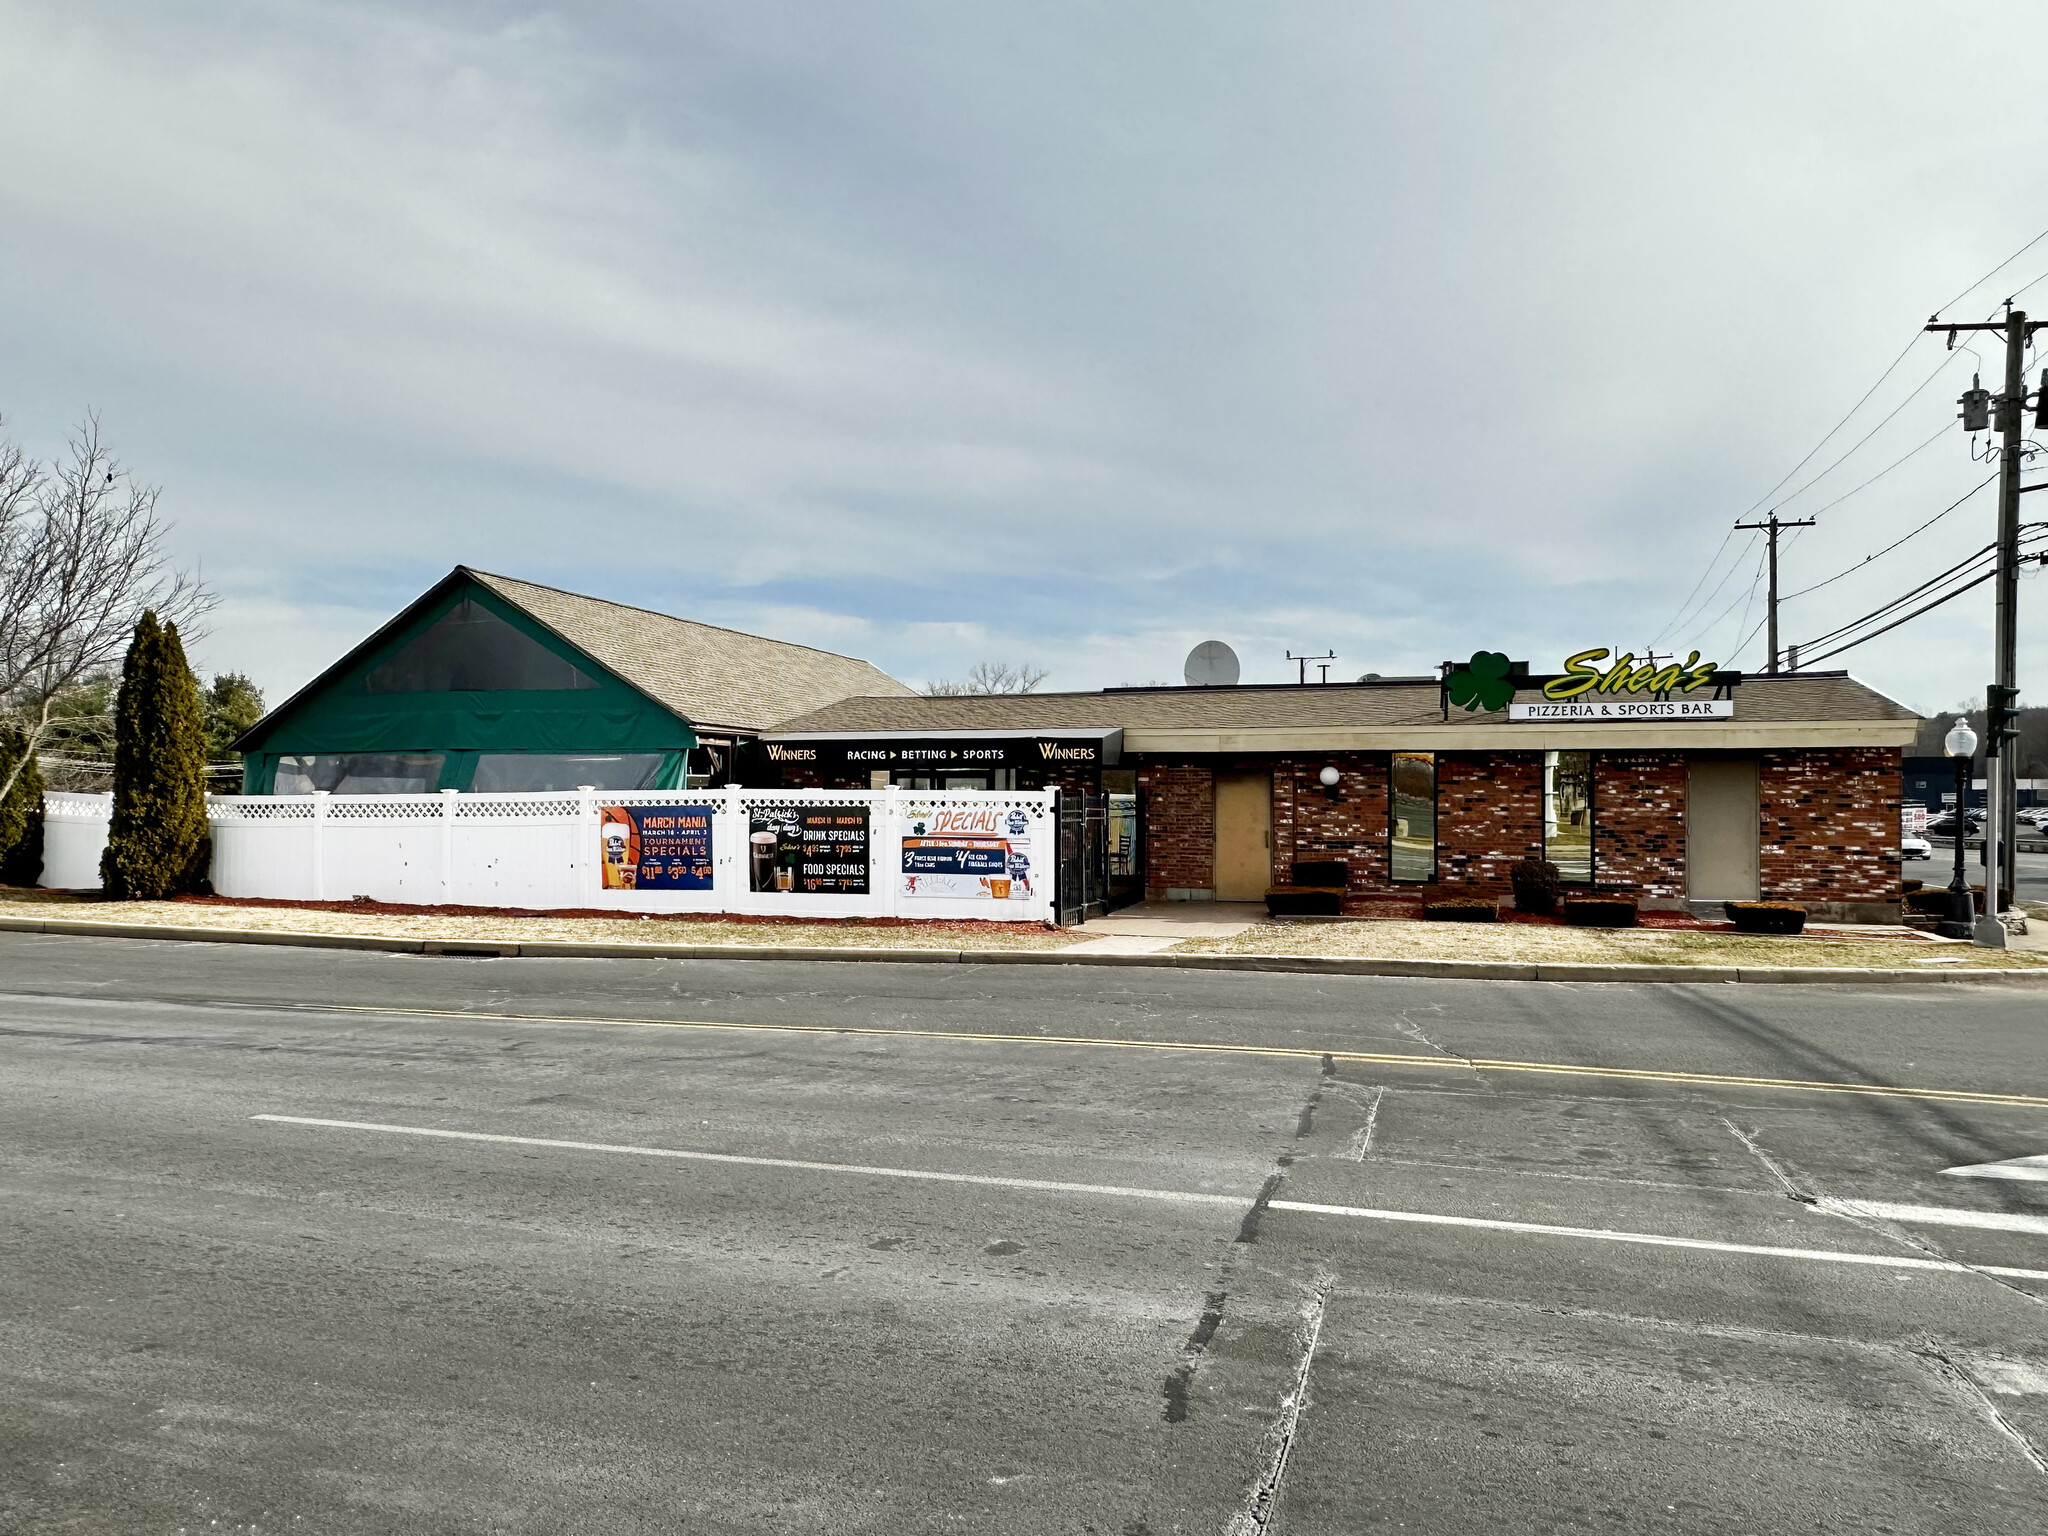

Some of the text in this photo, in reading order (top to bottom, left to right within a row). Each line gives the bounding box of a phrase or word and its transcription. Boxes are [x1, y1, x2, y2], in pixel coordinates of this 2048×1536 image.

[1542, 648, 1718, 700] Shea's
[1528, 703, 1714, 717] PIZZERIA & SPORTS BAR
[847, 750, 1004, 760] RACING BETTING SPORTS
[643, 816, 707, 828] MARCH MANIA
[932, 810, 1003, 831] SPECIALS
[644, 837, 707, 845] TOURNAMENT
[803, 830, 865, 841] DRINK SPECIALS
[644, 846, 707, 856] SPECIALS
[803, 863, 865, 875] FOOD SPECIALS
